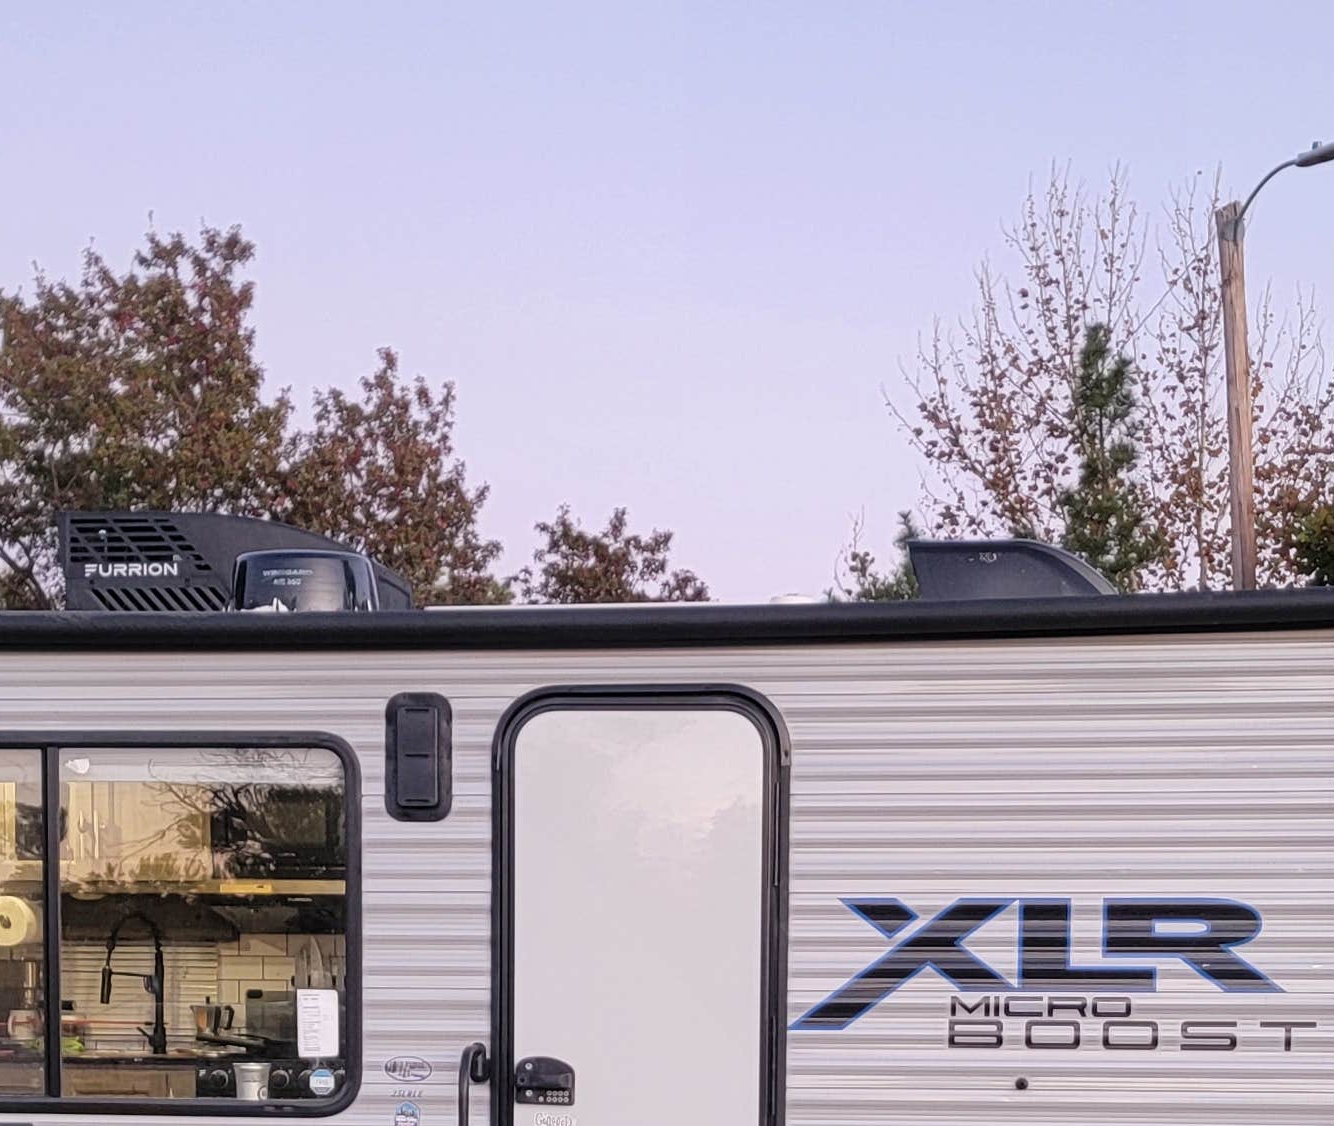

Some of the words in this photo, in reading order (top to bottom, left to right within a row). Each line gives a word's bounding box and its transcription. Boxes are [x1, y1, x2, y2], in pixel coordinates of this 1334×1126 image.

[84, 562, 178, 577] FURRION
[787, 896, 1287, 1031] XLR
[950, 995, 1132, 1018] MICRO
[947, 1020, 1318, 1053] BOOST
